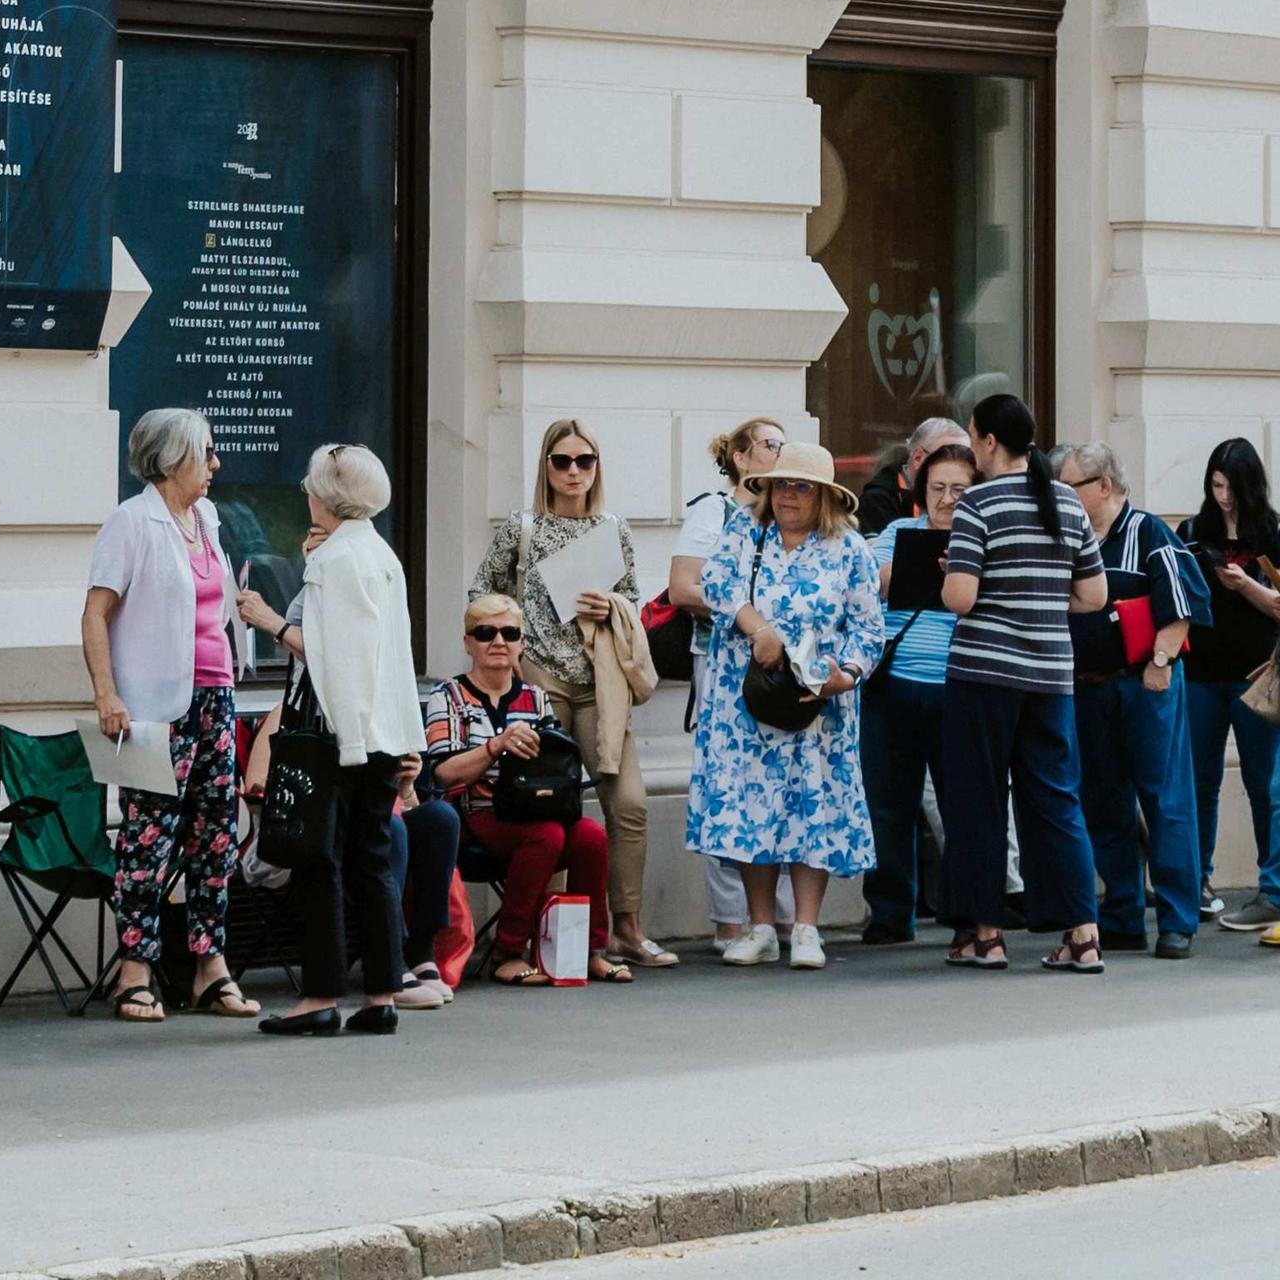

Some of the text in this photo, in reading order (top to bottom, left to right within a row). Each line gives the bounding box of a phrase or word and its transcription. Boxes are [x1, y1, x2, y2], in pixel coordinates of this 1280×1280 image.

[4, 42, 62, 57] AKARTOK
[188, 201, 304, 214] SZERELMES SHAKESPEARE
[210, 220, 283, 231] MANON LESCAUT
[201, 254, 291, 267] MATYI ELSZABADUL,
[202, 284, 290, 295] A MOSOLY ORSZÁGA
[183, 300, 307, 313] POMÁDÉ KIRÁLY ÚJ RUHÁJA
[170, 317, 320, 331] VÍZKERESZT, VAGY AMIT AKARTOK
[206, 336, 285, 347] AZ ELTÖRT KORSÓ
[176, 354, 182, 362] A
[185, 353, 201, 363] KÉT
[206, 355, 234, 364] KOREA
[227, 372, 263, 382] AZ AJTÓ
[207, 390, 213, 398] A
[262, 391, 282, 400] RITA
[257, 408, 292, 417] OKOSAN
[214, 425, 275, 434] GENGSZTEREK
[215, 442, 279, 452] EKETE HATTYÚ
